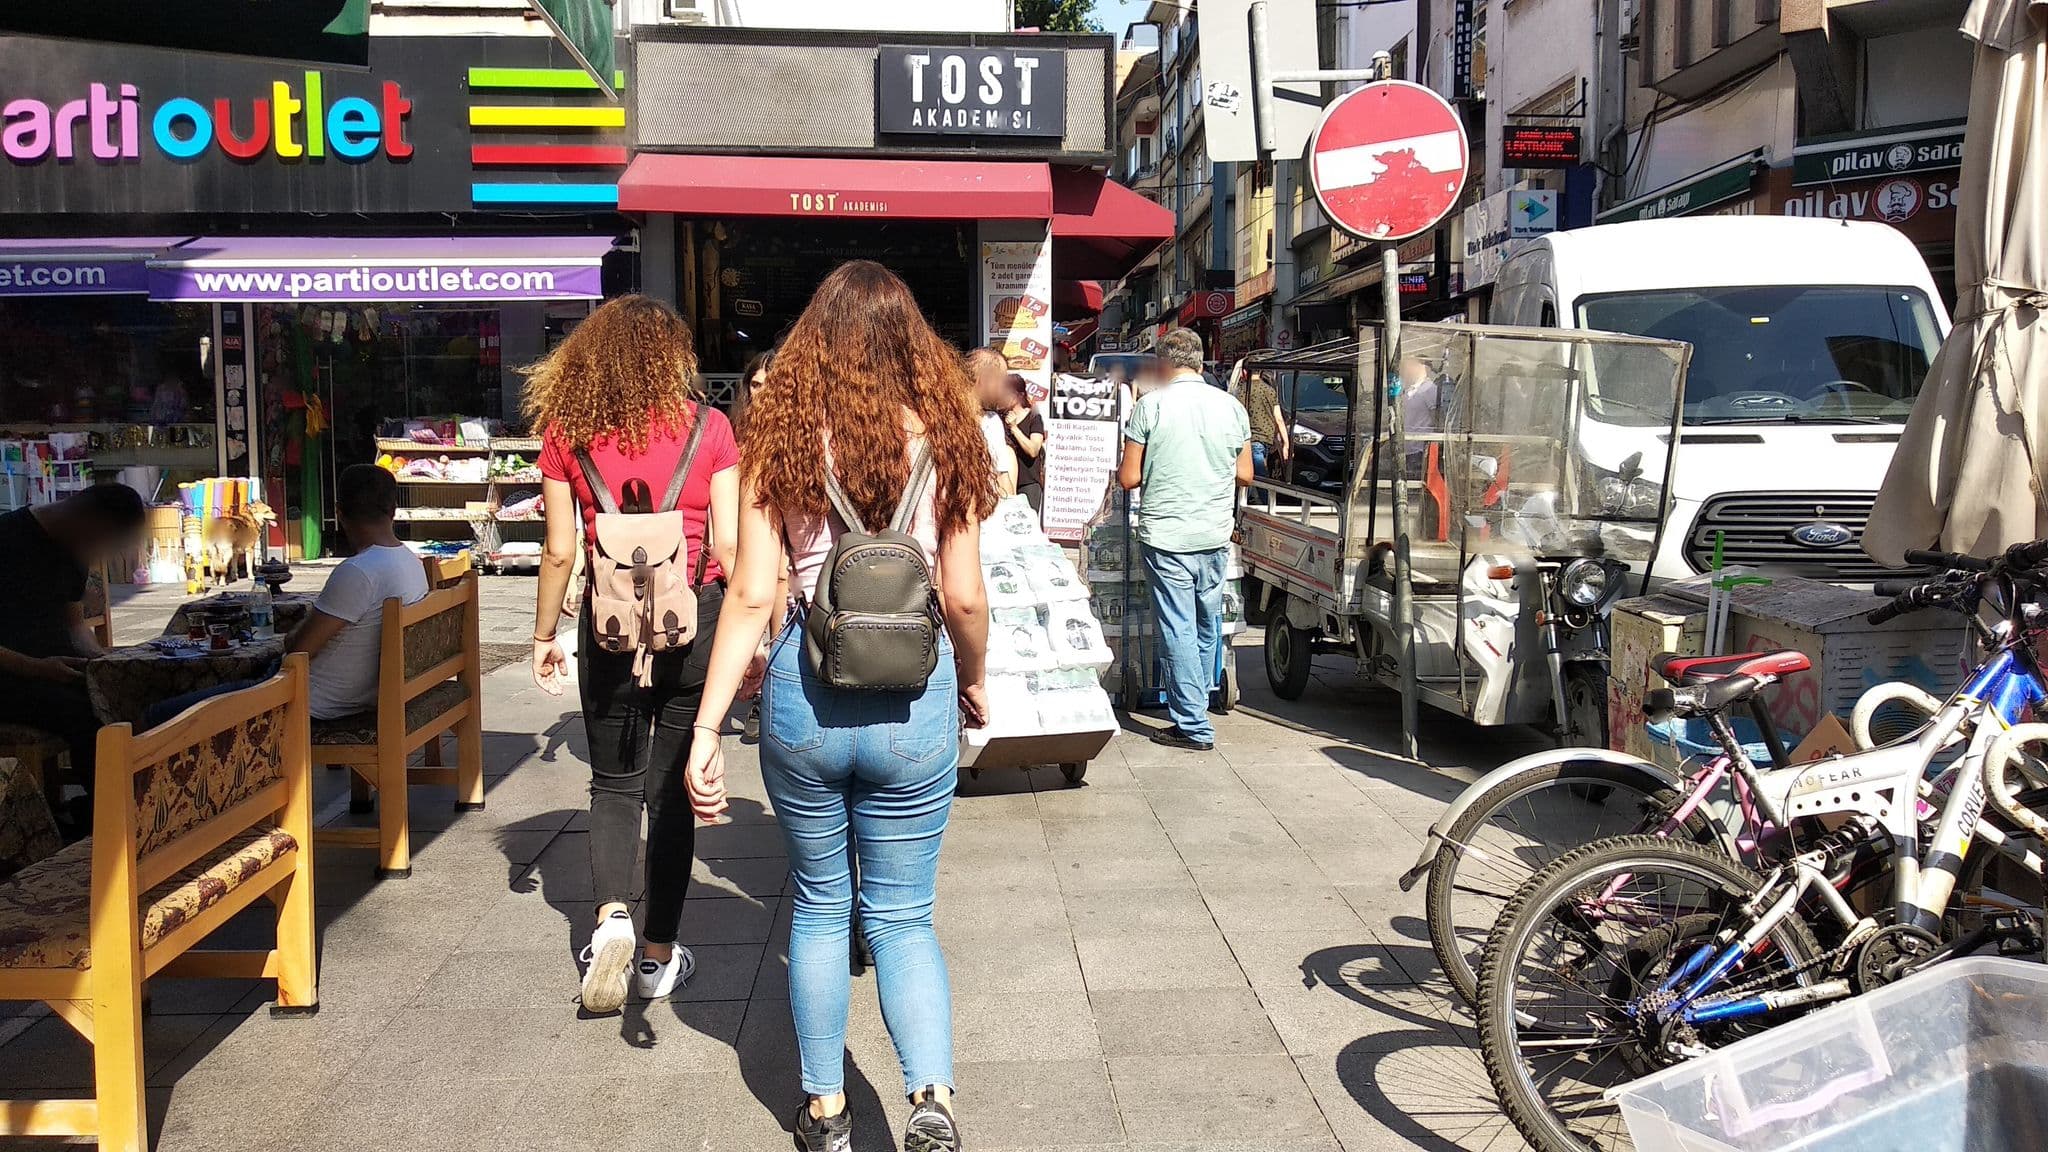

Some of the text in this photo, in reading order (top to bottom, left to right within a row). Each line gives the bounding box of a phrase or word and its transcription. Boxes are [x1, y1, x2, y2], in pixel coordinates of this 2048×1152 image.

[1456, 3, 1465, 75] MAHALLE
[909, 54, 1039, 106] TOST
[152, 71, 414, 158] outlet
[1832, 151, 1884, 175] pilav
[790, 193, 837, 211] TOST
[194, 266, 556, 298] www.partioutlet.com
[997, 272, 1014, 280] adet
[1053, 396, 1116, 417] TOST
[1089, 445, 1104, 453] Tost
[1090, 476, 1105, 484] Tost
[1052, 495, 1073, 503] Hindi
[1806, 527, 1840, 541] Ford
